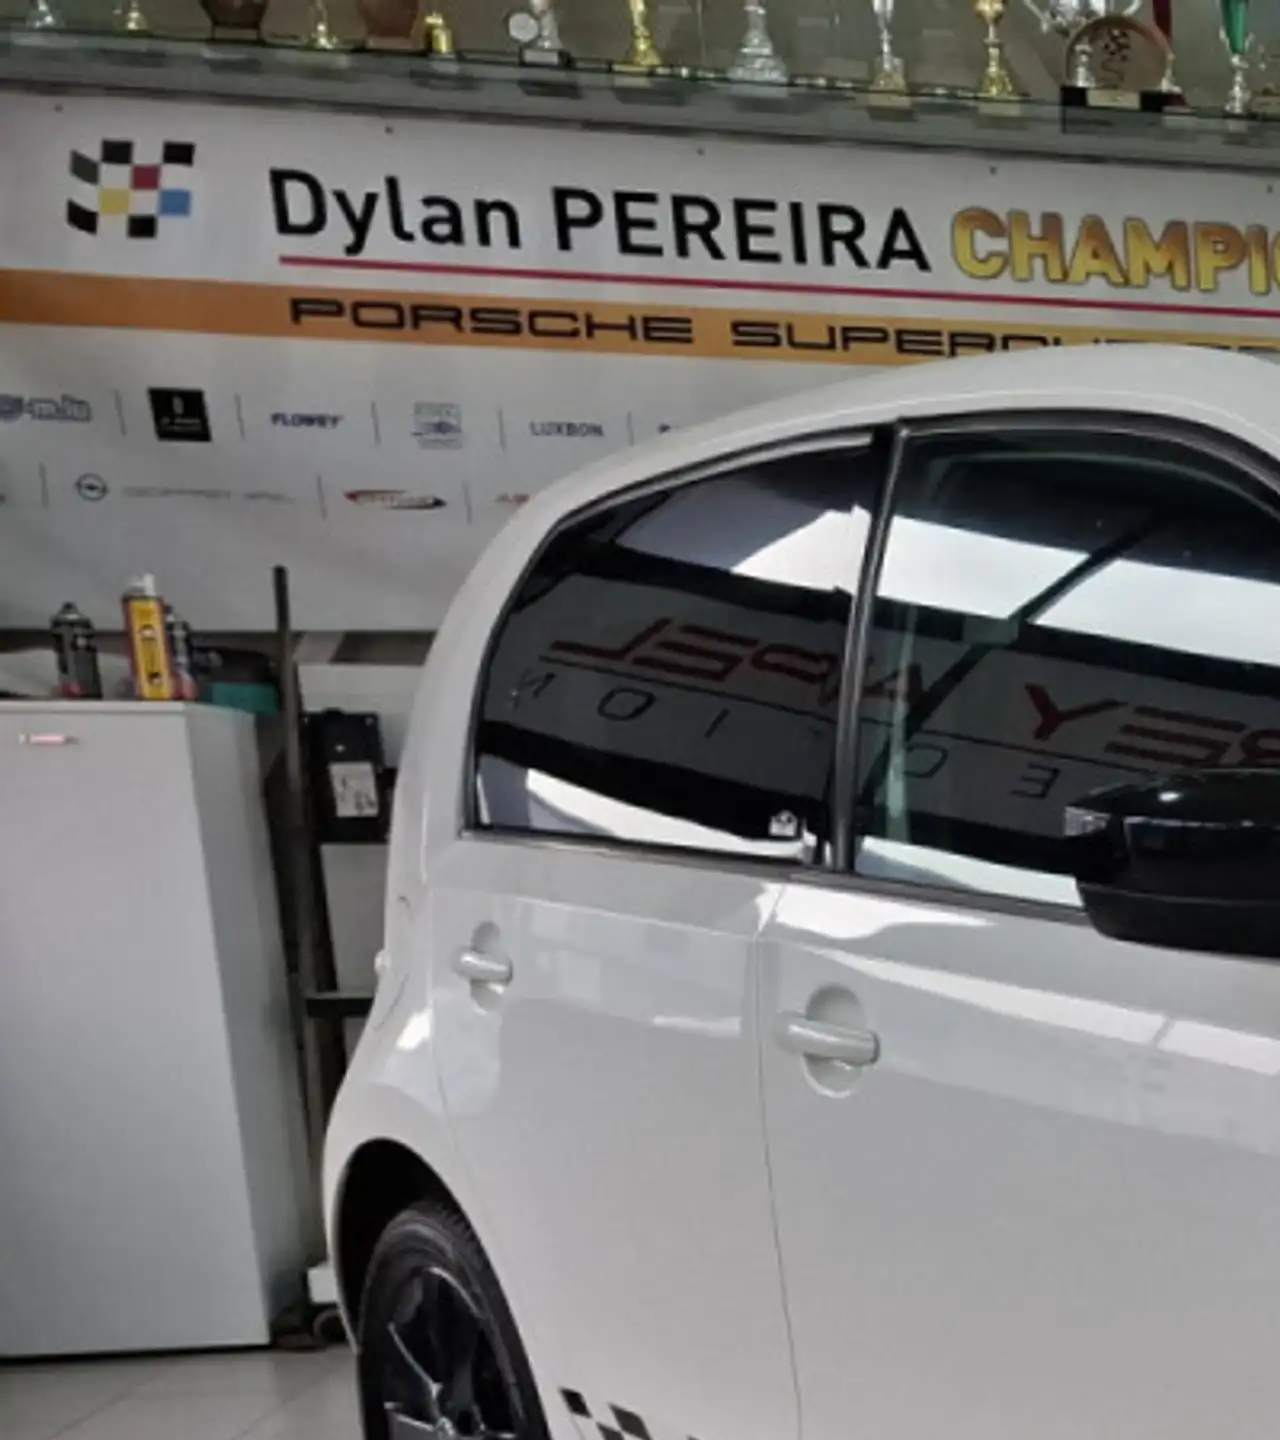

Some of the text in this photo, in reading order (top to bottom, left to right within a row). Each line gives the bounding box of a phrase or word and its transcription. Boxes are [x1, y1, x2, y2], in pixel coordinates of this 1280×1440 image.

[269, 168, 521, 256] Dylan
[552, 186, 932, 272] PEREIRA
[290, 297, 694, 346] PORSCHE
[730, 319, 1150, 359] SUPER
